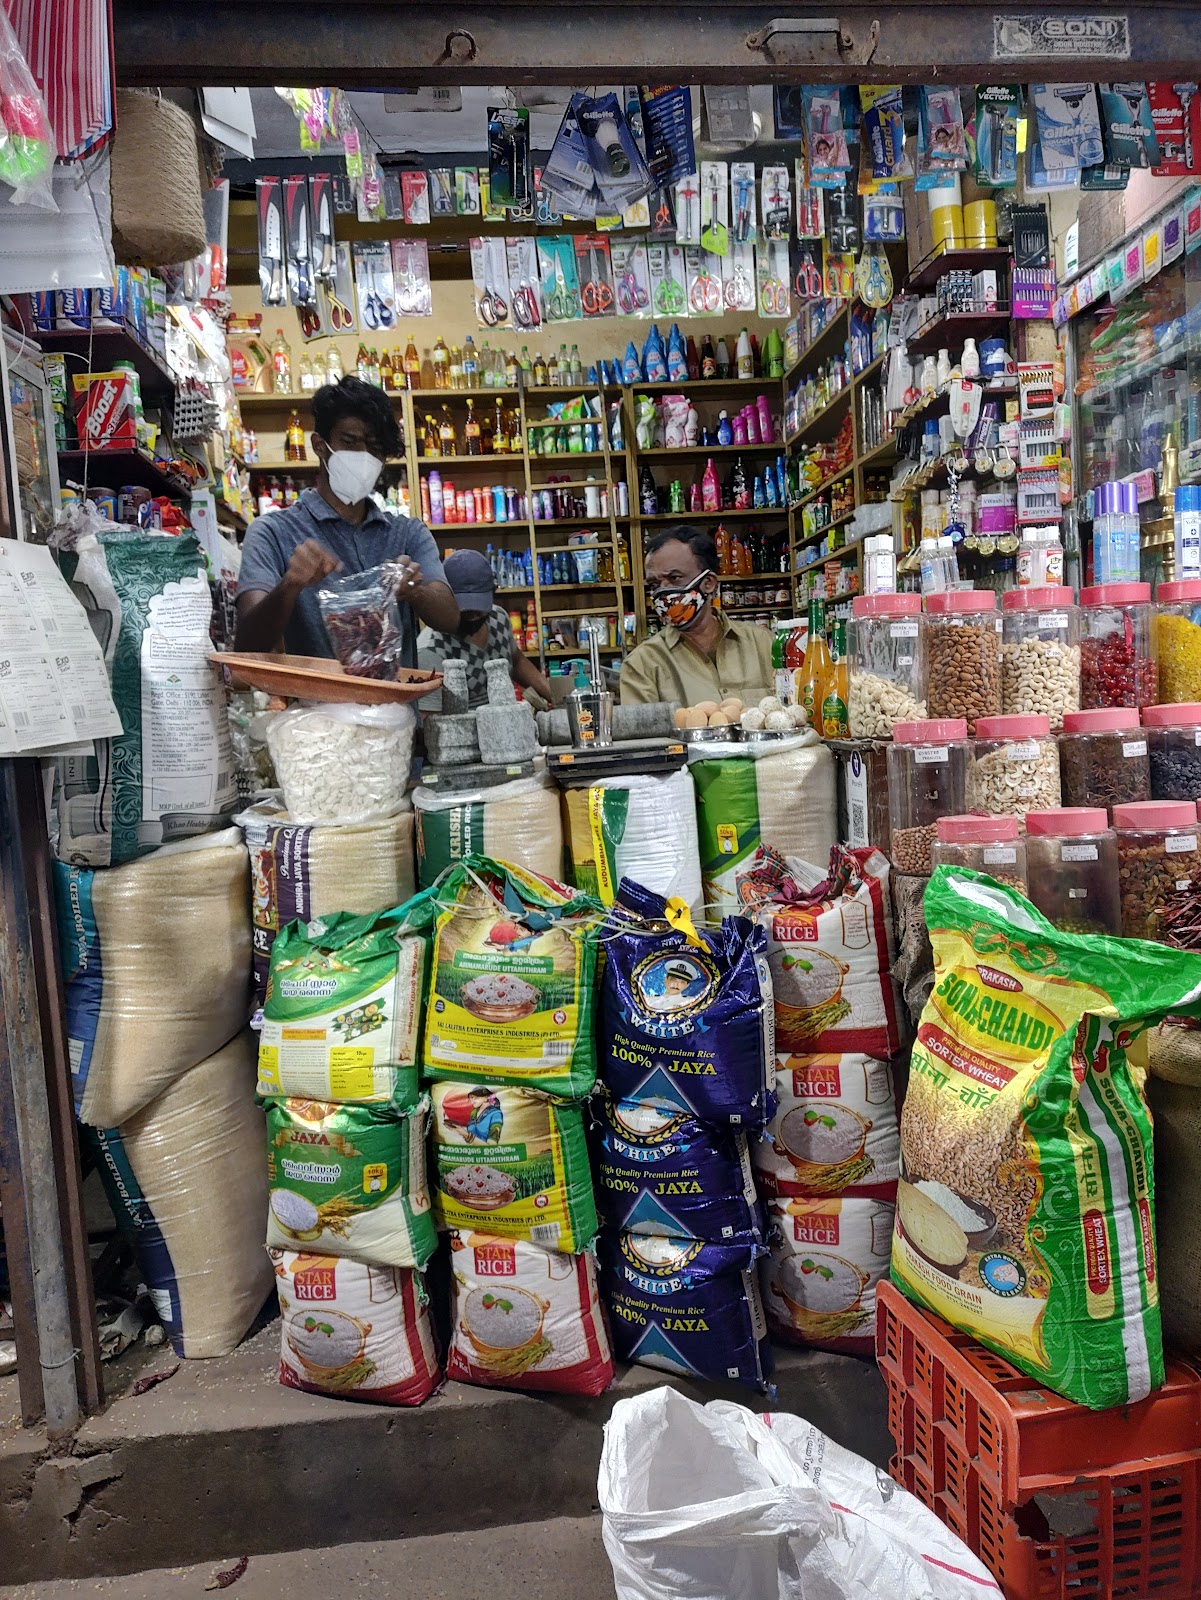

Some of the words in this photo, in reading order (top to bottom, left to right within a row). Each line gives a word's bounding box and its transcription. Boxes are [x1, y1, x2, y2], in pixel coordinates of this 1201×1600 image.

[1046, 18, 1113, 36] SONI
[489, 111, 527, 126] LASER
[1151, 108, 1183, 118] Gillette
[1110, 122, 1151, 137] Gillette
[876, 124, 884, 164] Gillette
[884, 125, 895, 167] Guard
[86, 380, 119, 436] Boost
[463, 826, 472, 858] OILED
[293, 862, 303, 881] JAYA
[294, 881, 304, 914] ANDHRA
[69, 881, 86, 933] BOILED
[775, 926, 816, 941] RICE
[661, 938, 683, 947] NEW
[77, 935, 88, 969] JAYA
[458, 961, 501, 972] AMMAMARUDE
[502, 965, 547, 974] UTTAMITHRAM
[978, 968, 1017, 991] PRAKASH
[466, 1027, 504, 1036] ENTERPRISES
[505, 1029, 540, 1038] INDUSTRIES
[629, 1012, 695, 1038] WHITE
[614, 1033, 630, 1046] High
[630, 1040, 657, 1054] Quality
[659, 1046, 695, 1058] Premium
[696, 1050, 716, 1059] Rice
[611, 1044, 652, 1068] 100%
[668, 1060, 718, 1075] JAYA
[926, 1037, 966, 1070] SORTEX
[967, 1064, 1009, 1088] WHEAT
[971, 1054, 1001, 1073] QUALITY
[794, 1068, 836, 1082] STAR
[795, 1081, 839, 1096] RICE
[290, 1131, 331, 1146] JAYA
[613, 1137, 677, 1162] WHITE
[475, 1155, 520, 1163] UTTAMITHRAM
[615, 1167, 643, 1179] Quality
[643, 1169, 679, 1179] Premium
[681, 1168, 700, 1178] Rice
[655, 1180, 703, 1195] JAYA
[457, 1211, 492, 1221] ENTERPRISES
[797, 1216, 835, 1230] STAR
[797, 1228, 837, 1244] RICE
[1092, 1217, 1105, 1248] WHEAT
[476, 1245, 512, 1260] STAR
[984, 1253, 1002, 1263] EXTRA
[1002, 1253, 1018, 1267] BOLD
[477, 1259, 514, 1275] RICE
[1096, 1249, 1107, 1284] SORTEX
[296, 1270, 332, 1286] STAR
[623, 1266, 682, 1293] WHITE
[297, 1284, 336, 1300] RICE
[931, 1272, 952, 1291] FOOD
[954, 1286, 983, 1305] GRAIN
[1000, 1276, 1026, 1298] CLEANED
[624, 1296, 650, 1310] Quality
[651, 1302, 686, 1315] Premium
[687, 1306, 706, 1316] Rice
[661, 1317, 710, 1332] JAYA
